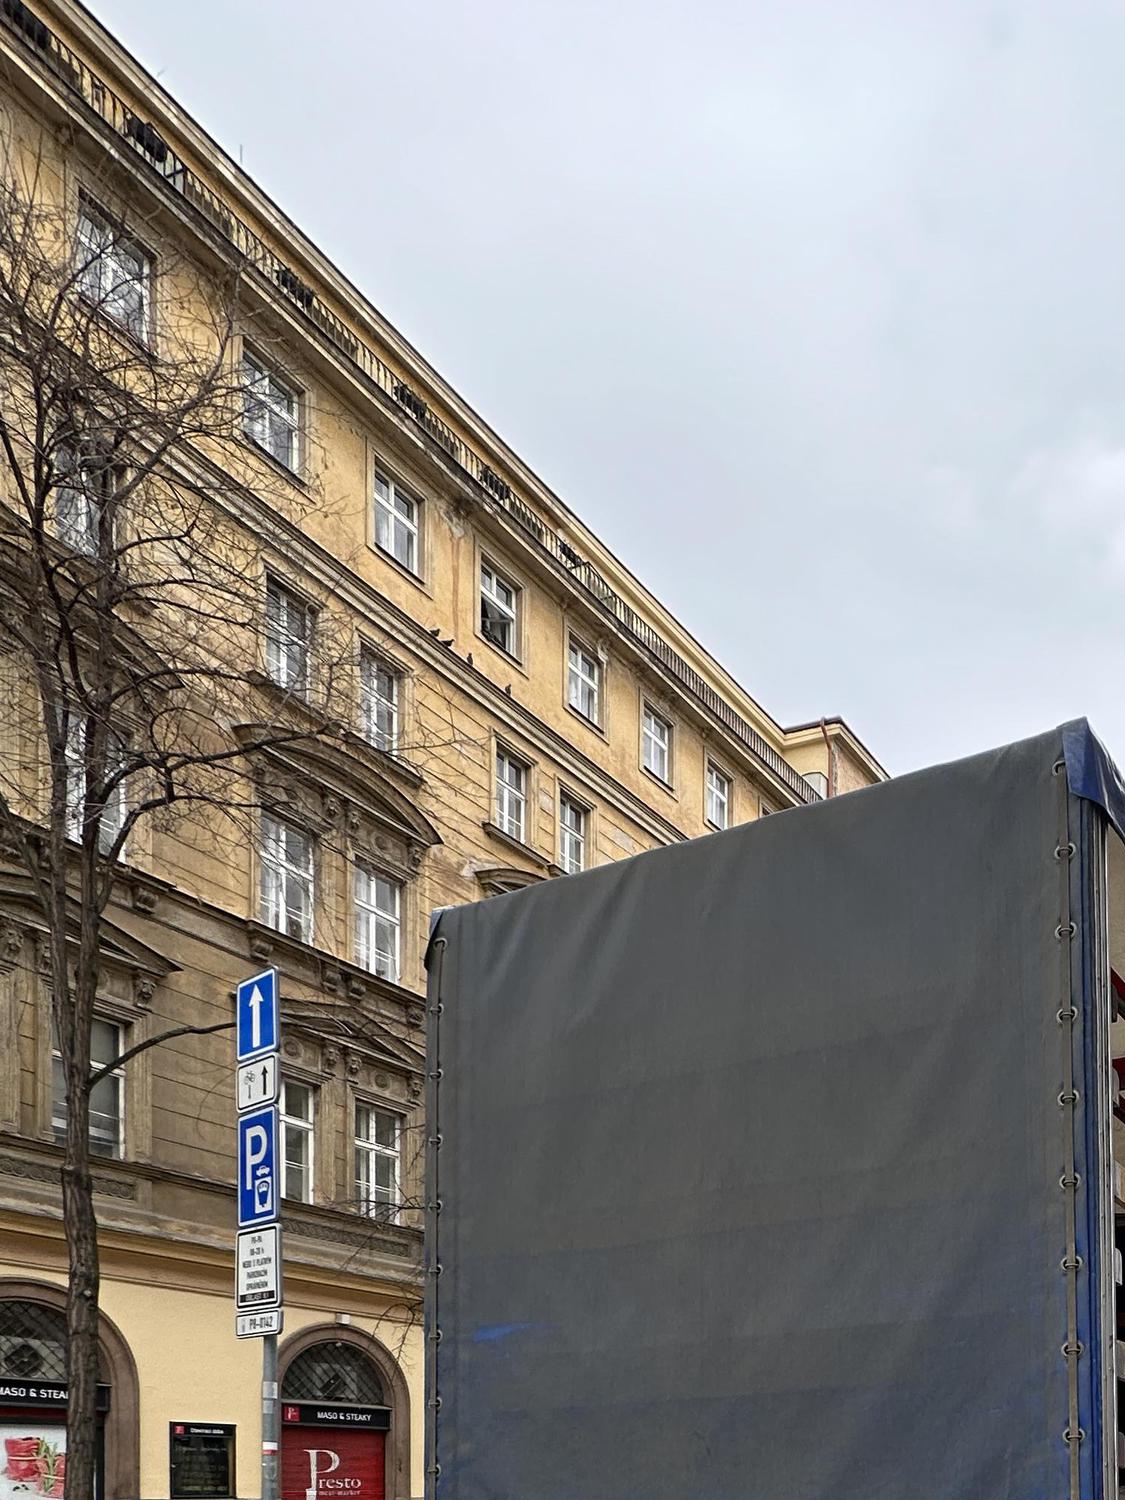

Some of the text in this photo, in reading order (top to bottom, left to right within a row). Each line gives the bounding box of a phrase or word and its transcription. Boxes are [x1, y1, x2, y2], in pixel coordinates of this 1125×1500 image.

[245, 1124, 268, 1190] P
[29, 1388, 37, 1397] &
[317, 1411, 372, 1421] MASO & STEAKY
